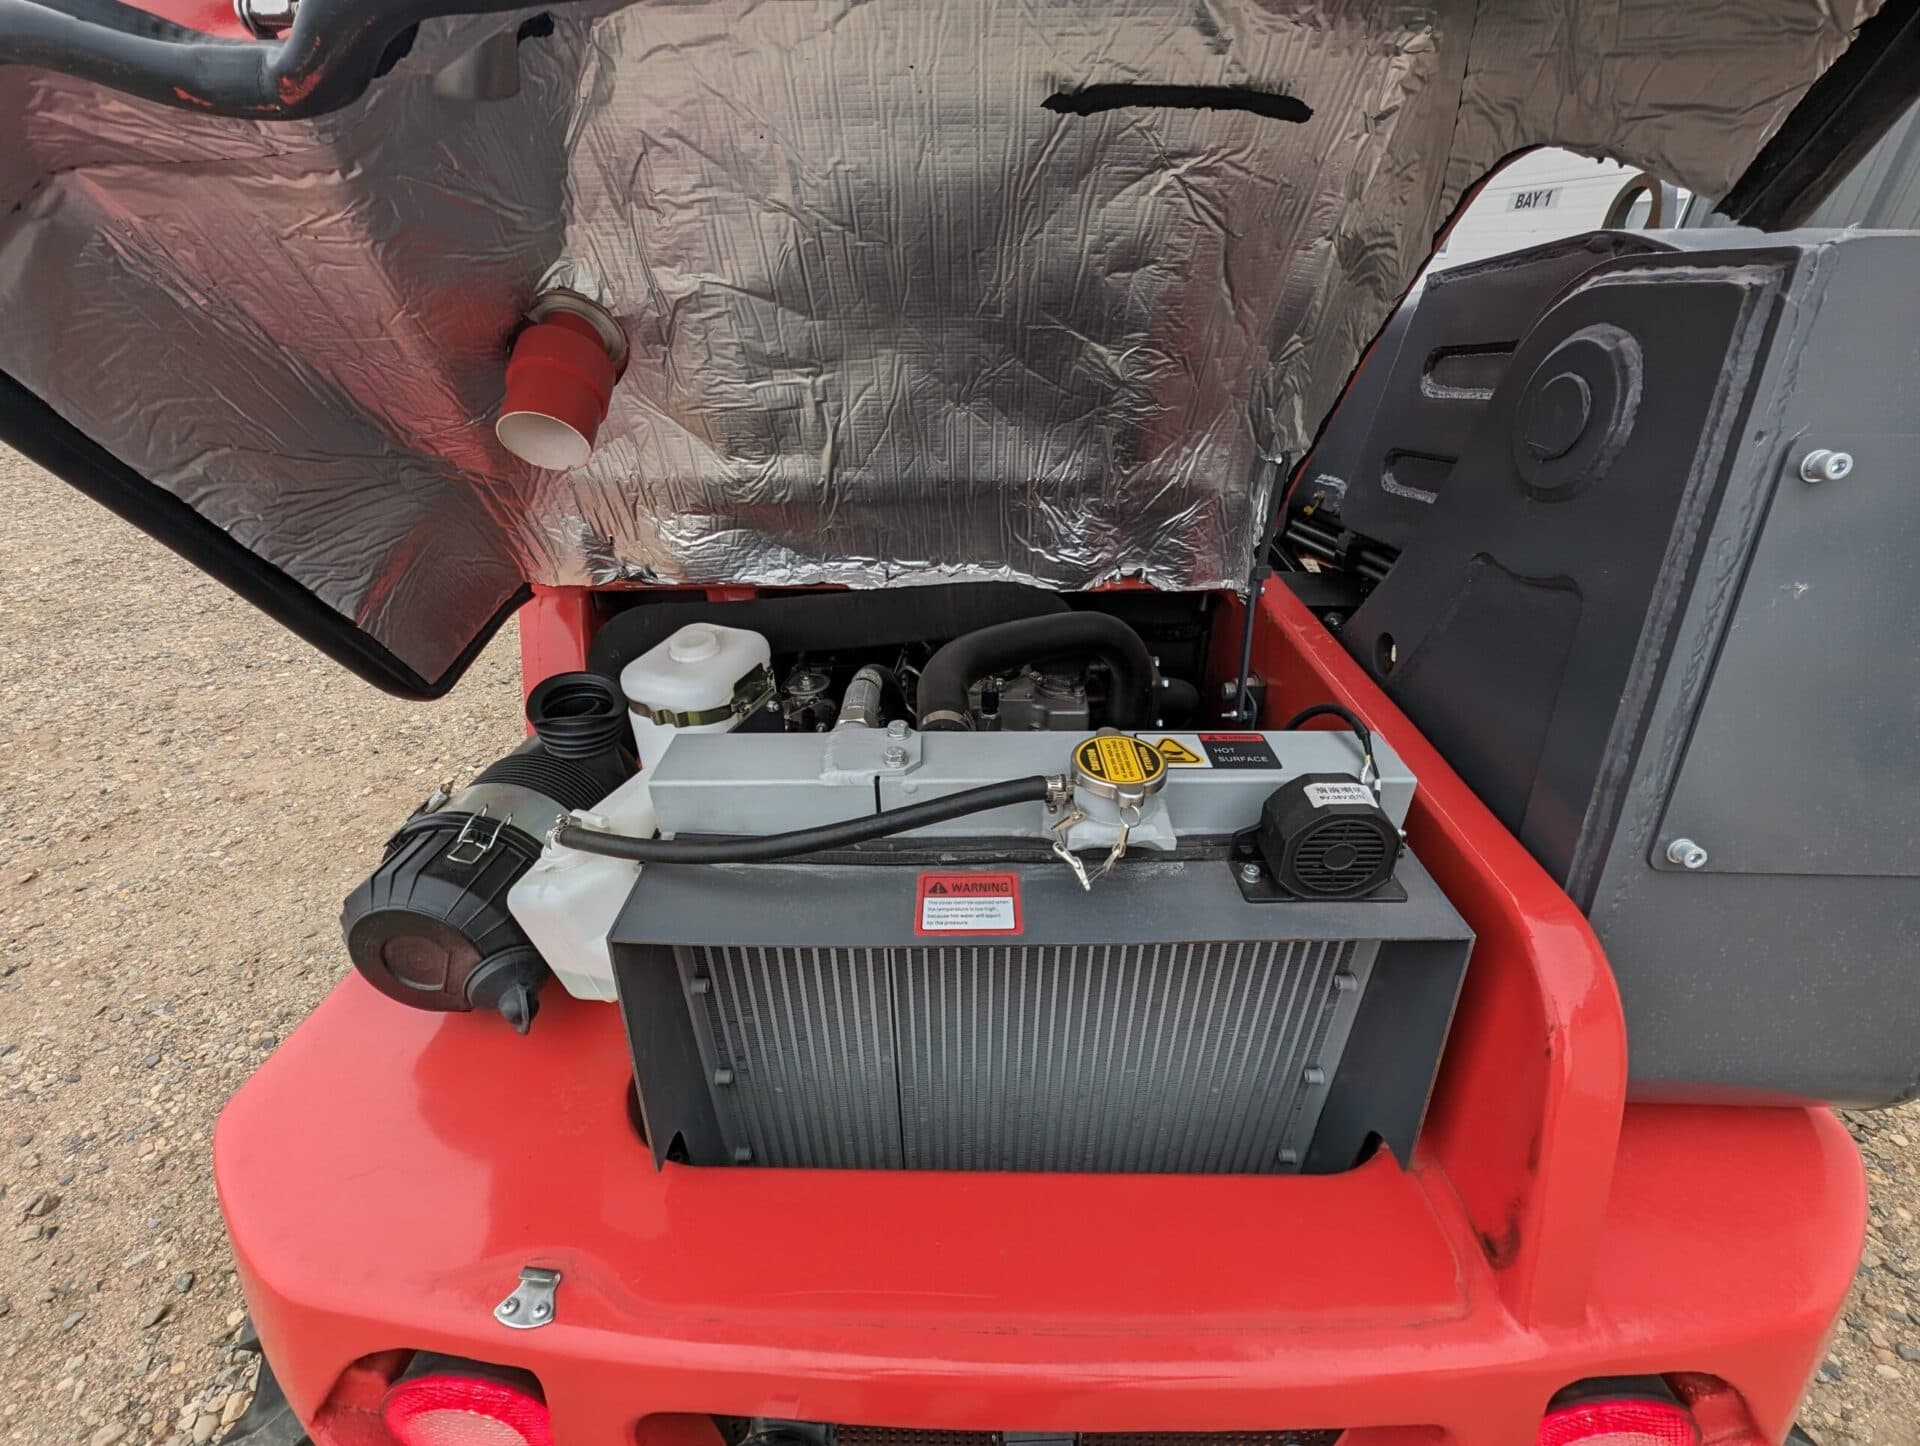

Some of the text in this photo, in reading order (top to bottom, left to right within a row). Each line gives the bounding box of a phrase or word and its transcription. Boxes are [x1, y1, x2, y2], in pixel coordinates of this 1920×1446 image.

[1514, 190, 1553, 209] BAY 1
[951, 882, 1009, 893] WARNING
